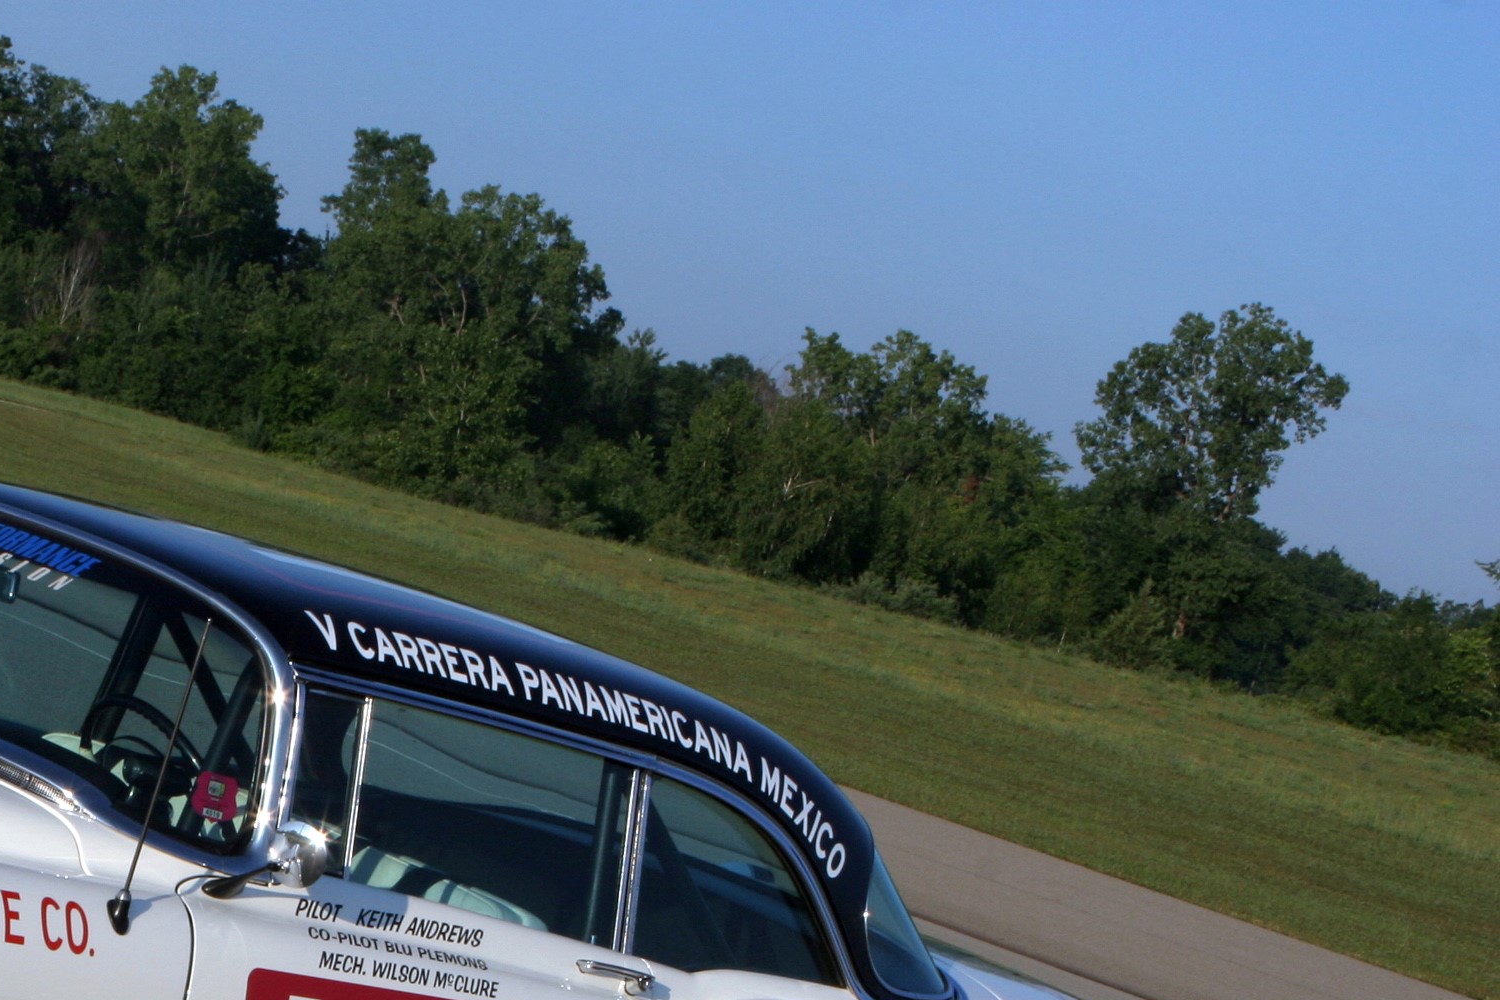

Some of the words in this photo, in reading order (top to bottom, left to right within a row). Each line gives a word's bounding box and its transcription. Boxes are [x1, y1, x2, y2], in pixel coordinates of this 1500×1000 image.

[304, 609, 337, 651] V
[347, 621, 514, 697] CARRERA
[515, 662, 752, 783] PANAMERICANA
[760, 757, 847, 879] MEXICO
[41, 897, 95, 957] CO.
[295, 899, 343, 923] PILOT
[356, 908, 404, 932] KEITH
[405, 917, 484, 947] ANDREWS
[308, 926, 379, 950] CO-PILOT
[417, 946, 488, 971] PLEMONS
[318, 951, 366, 976] MECH.
[372, 960, 430, 986] WILSON
